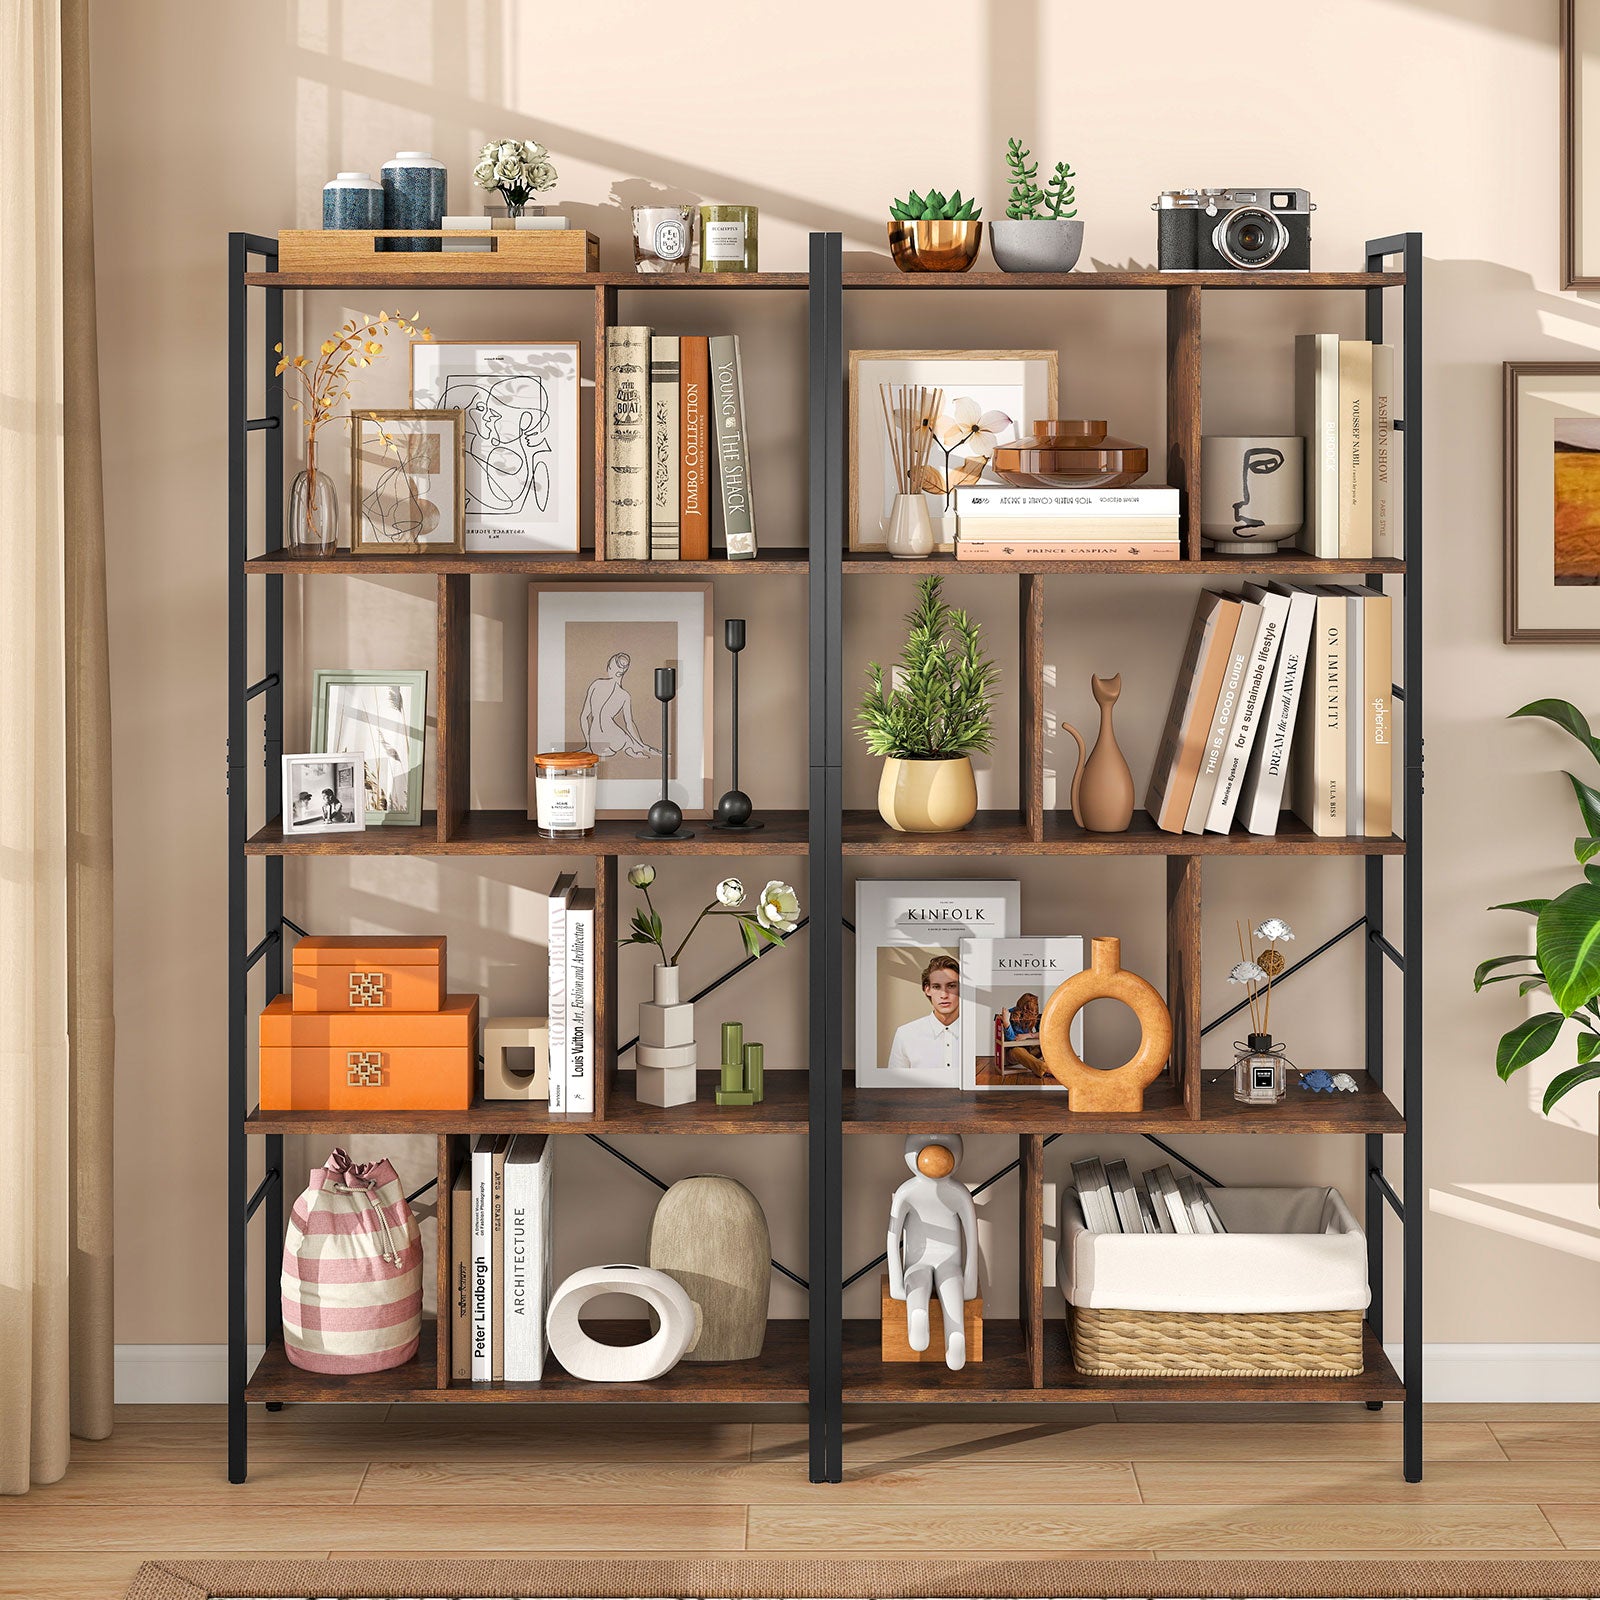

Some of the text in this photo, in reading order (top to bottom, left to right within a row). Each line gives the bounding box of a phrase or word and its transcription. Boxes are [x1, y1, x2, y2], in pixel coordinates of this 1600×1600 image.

[617, 402, 639, 413] BOAT
[685, 383, 701, 515] JUMBO COLLECTION
[717, 361, 746, 515] YOUNG THE SHACK
[1352, 399, 1360, 439] YOUSSEF
[1378, 396, 1388, 446] FASHION
[1378, 448, 1388, 484] SHOW
[1205, 654, 1245, 774] THIS IS A GOOD GUIDE
[1235, 622, 1277, 749] for a sustainable lifestyle
[1268, 654, 1299, 776] DREAM the world AWAKE
[1327, 627, 1339, 730] ON IMMUNITY
[1372, 698, 1389, 745] spherical
[1221, 757, 1240, 806] Marieke Eyskoot
[908, 908, 985, 920] KINFOLK
[998, 959, 1057, 968] KINFOLK
[552, 908, 565, 1046] AMERICAN DIOR
[571, 922, 585, 1078] Louis Vuitton Art, Fashion and Architecture
[474, 1256, 488, 1358] Peter Lindbergh
[514, 1208, 525, 1316] ARCHITECTURE
